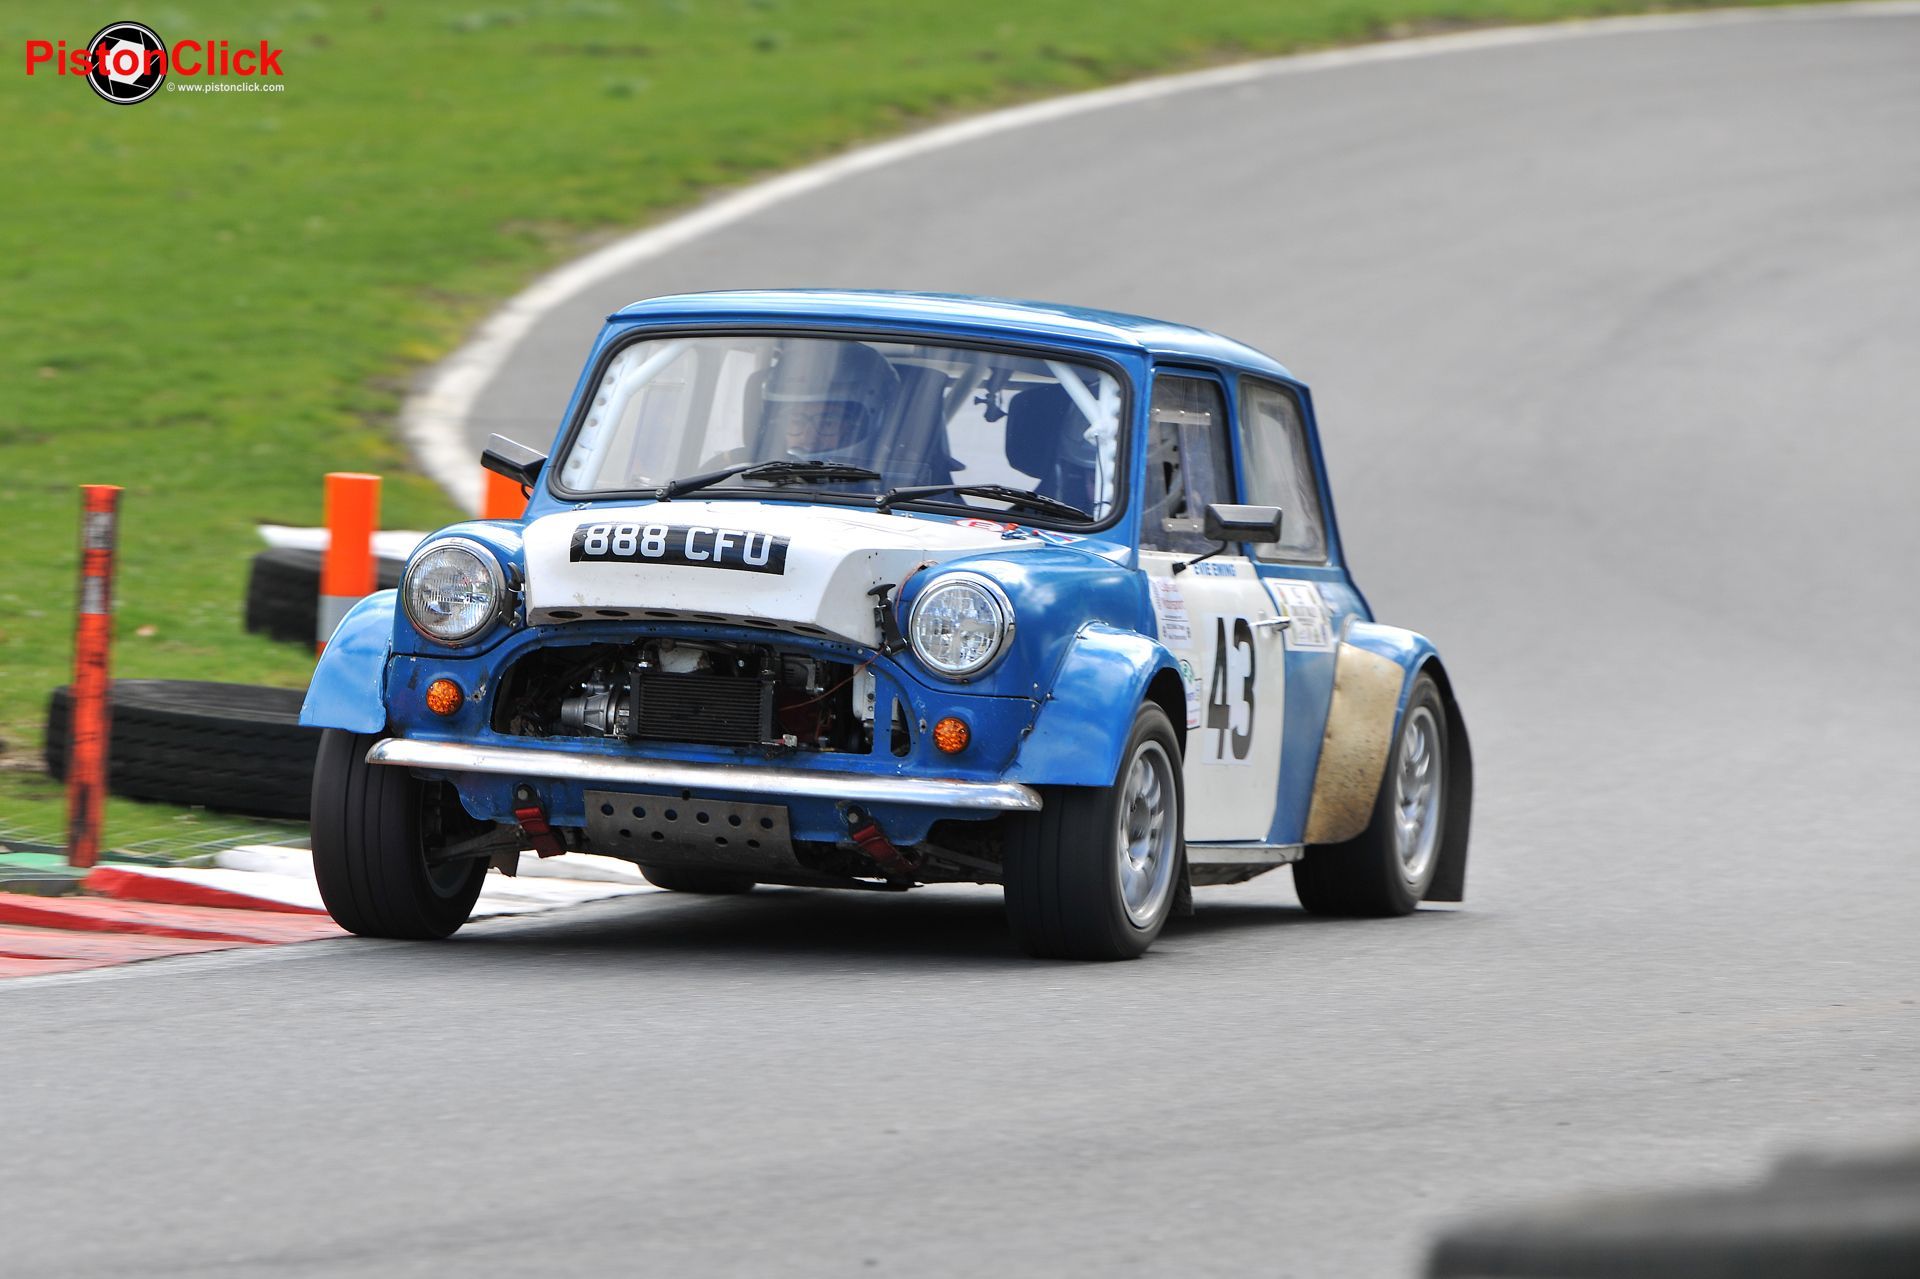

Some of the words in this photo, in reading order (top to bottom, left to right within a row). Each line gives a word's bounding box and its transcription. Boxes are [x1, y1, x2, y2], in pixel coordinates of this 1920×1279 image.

[584, 524, 669, 558] 888
[685, 526, 773, 566] CFU
[1207, 617, 1255, 760] 43
